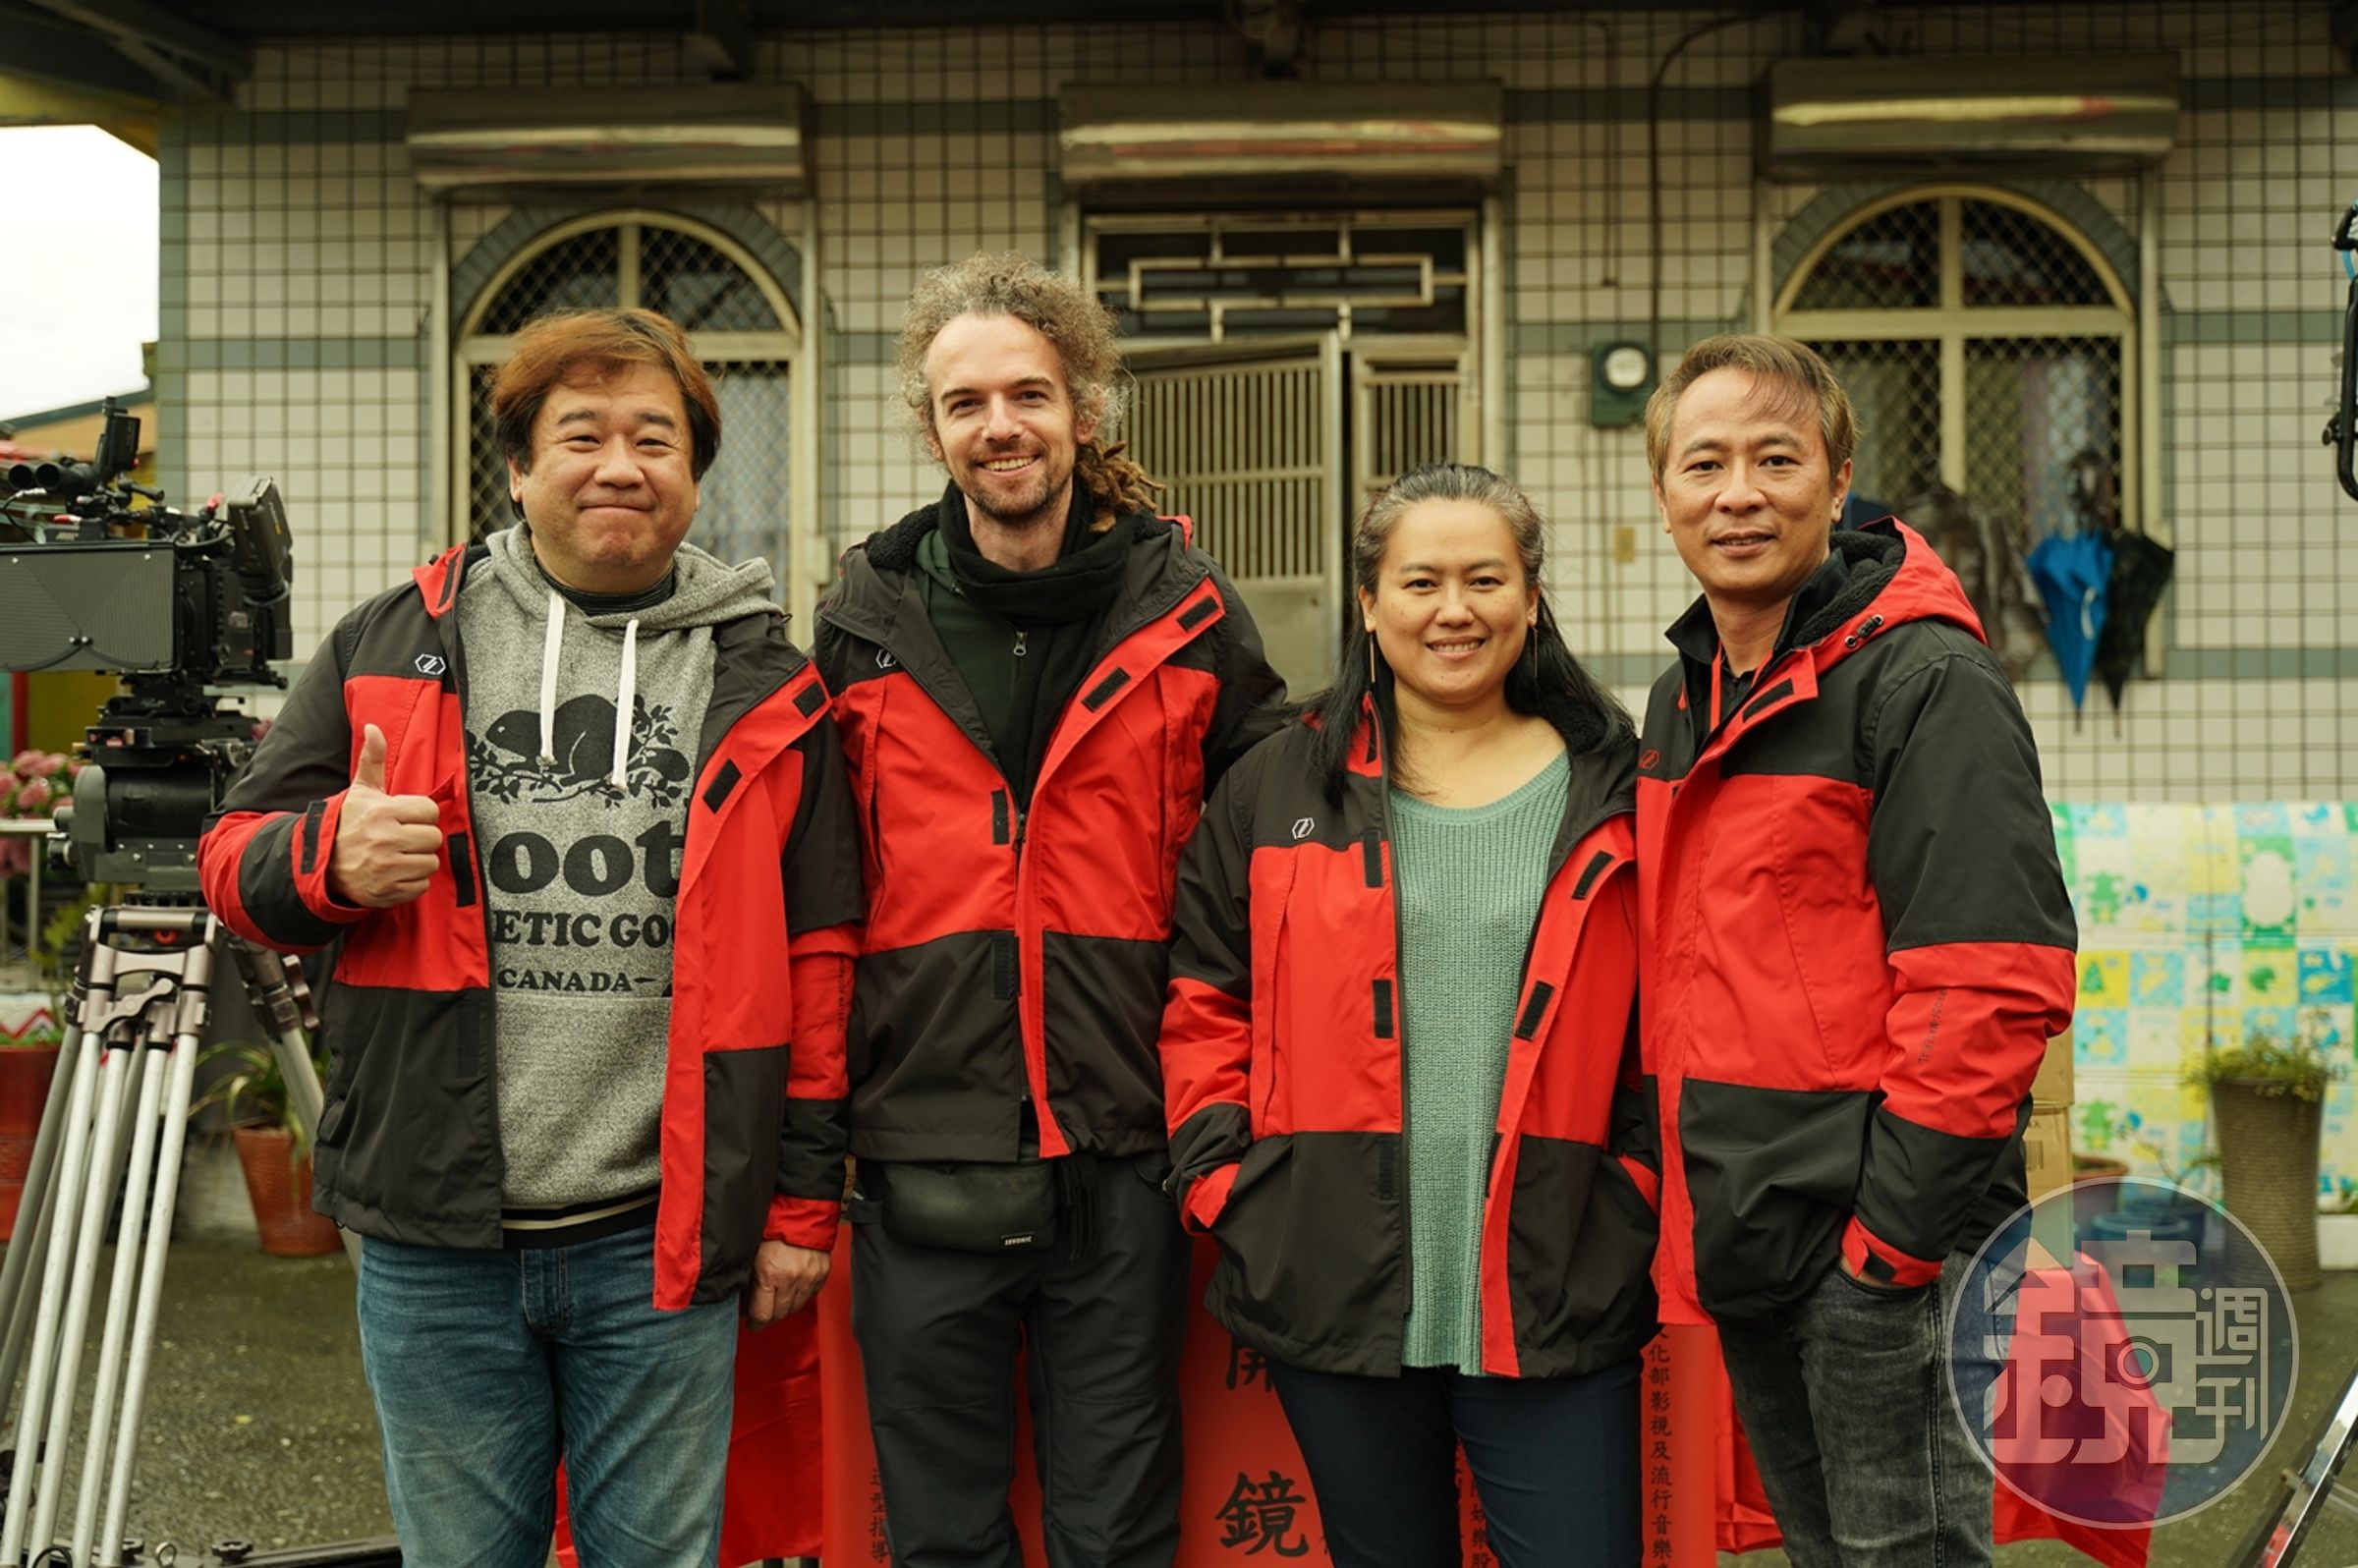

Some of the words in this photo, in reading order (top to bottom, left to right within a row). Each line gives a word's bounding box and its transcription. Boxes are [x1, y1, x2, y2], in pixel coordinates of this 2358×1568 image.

[609, 914, 677, 948] GO
[497, 968, 632, 992] CANADA
[1650, 1330, 1673, 1568] 化部影視及流行音樂
